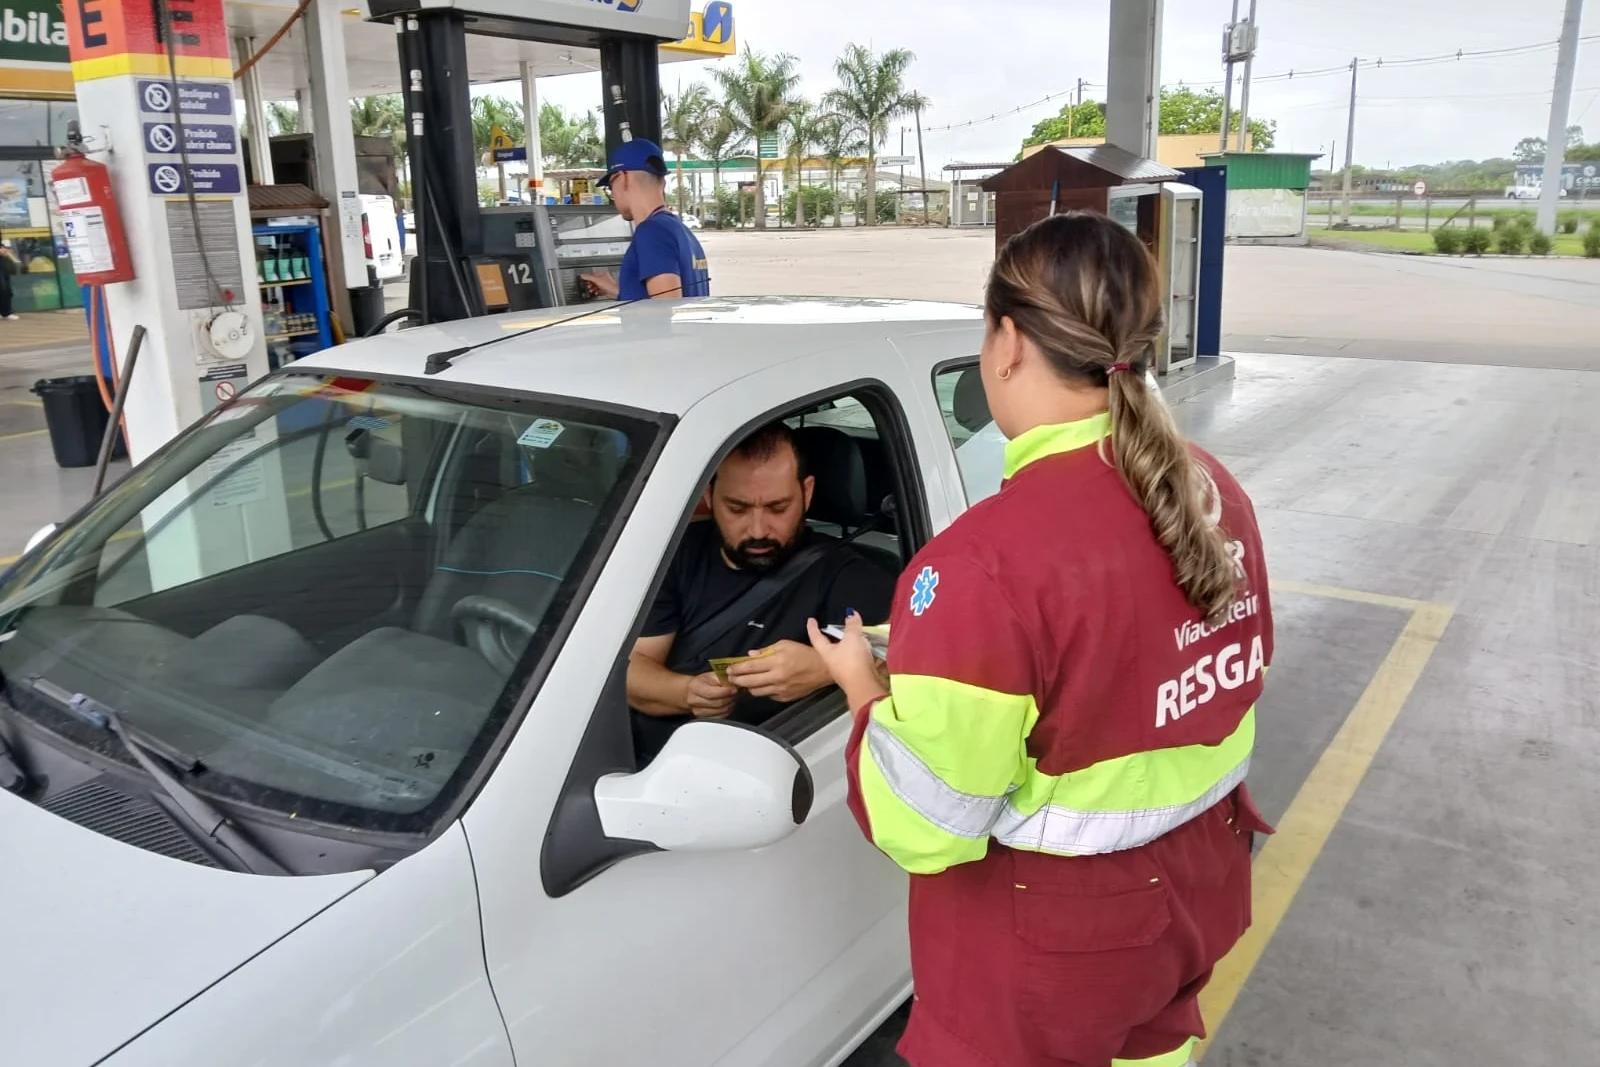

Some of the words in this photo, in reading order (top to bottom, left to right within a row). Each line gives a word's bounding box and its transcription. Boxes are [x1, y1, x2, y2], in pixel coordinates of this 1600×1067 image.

[0, 8, 68, 46] bila
[184, 129, 217, 138] Proibido
[508, 263, 533, 284] 12
[1174, 590, 1258, 652] Viacteir
[1155, 635, 1265, 728] RESGA
